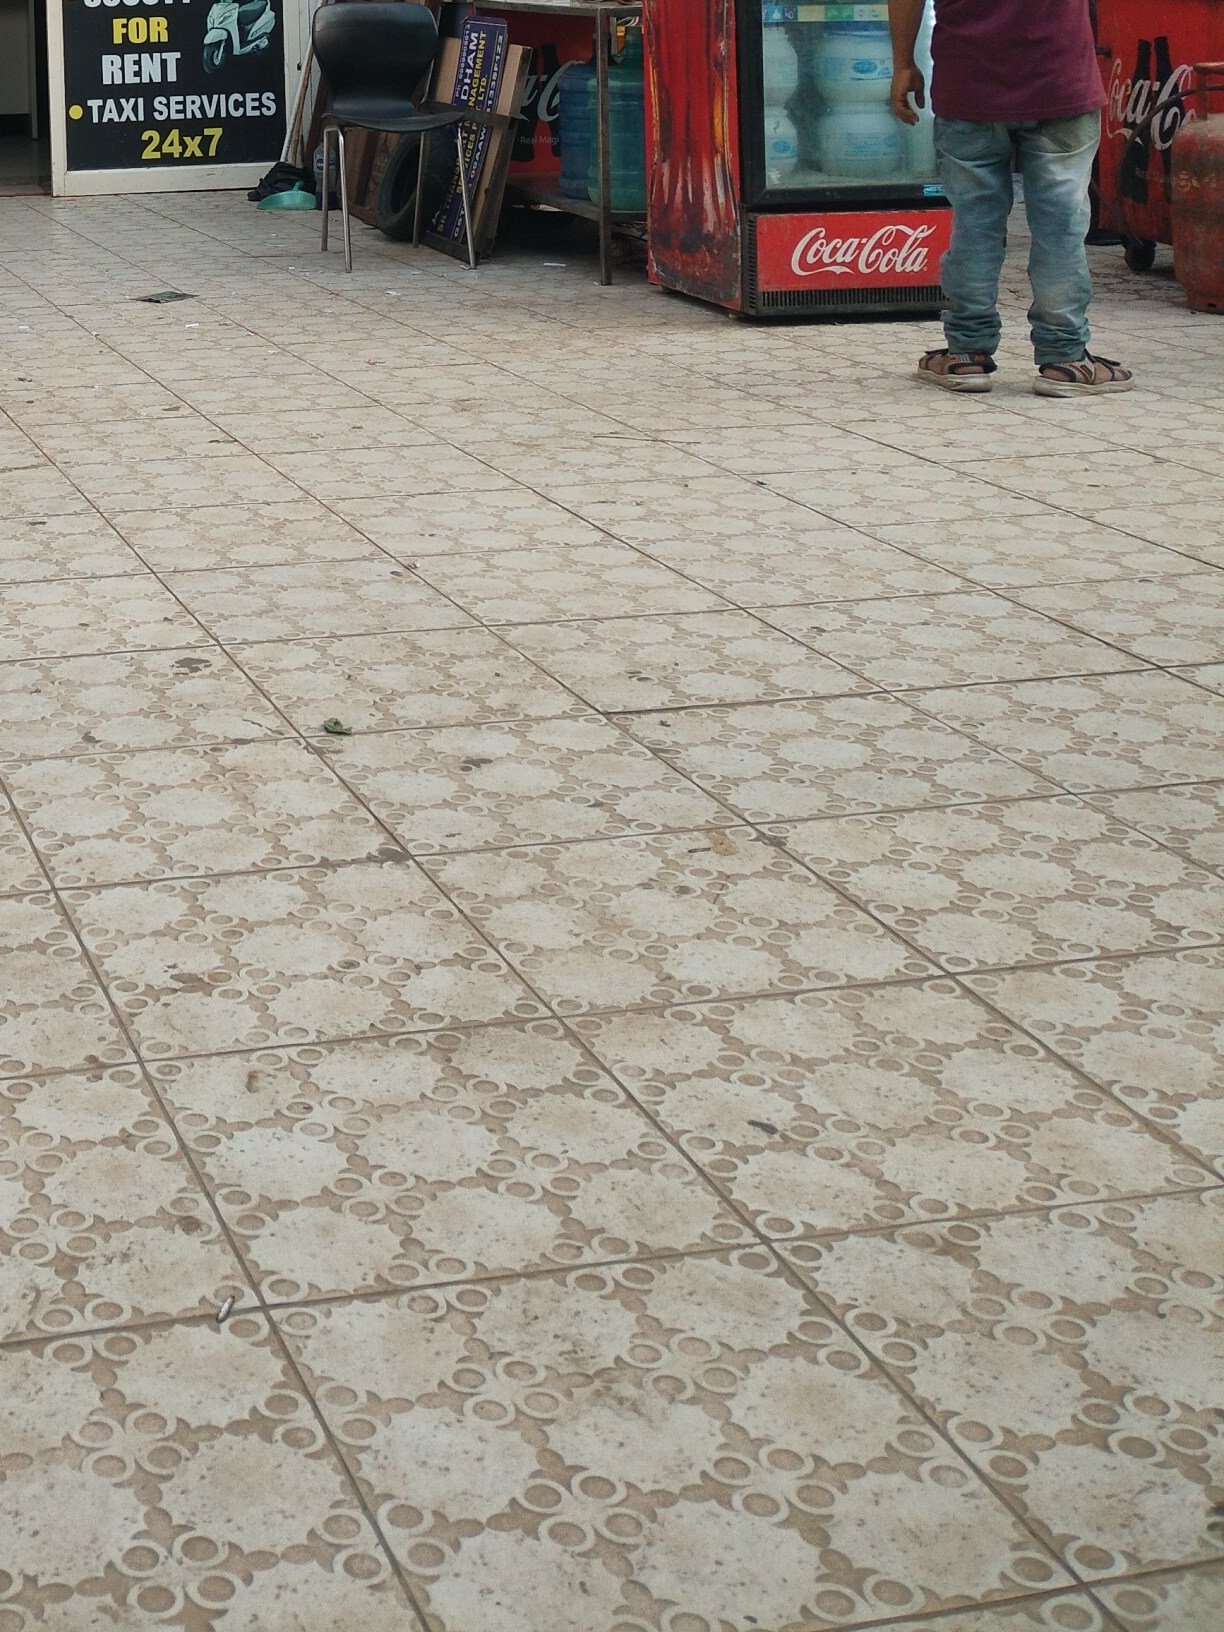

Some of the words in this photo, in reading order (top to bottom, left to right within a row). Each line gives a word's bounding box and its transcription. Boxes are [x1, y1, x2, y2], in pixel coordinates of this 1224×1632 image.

[112, 17, 168, 45] FOR
[101, 52, 181, 85] RENT
[460, 32, 479, 101] DHAM
[87, 97, 144, 124] TAXI
[153, 92, 276, 121] SERVICES
[141, 128, 223, 159] 24x7
[539, 135, 560, 146] Magi
[791, 224, 936, 275] Coca-Cola
